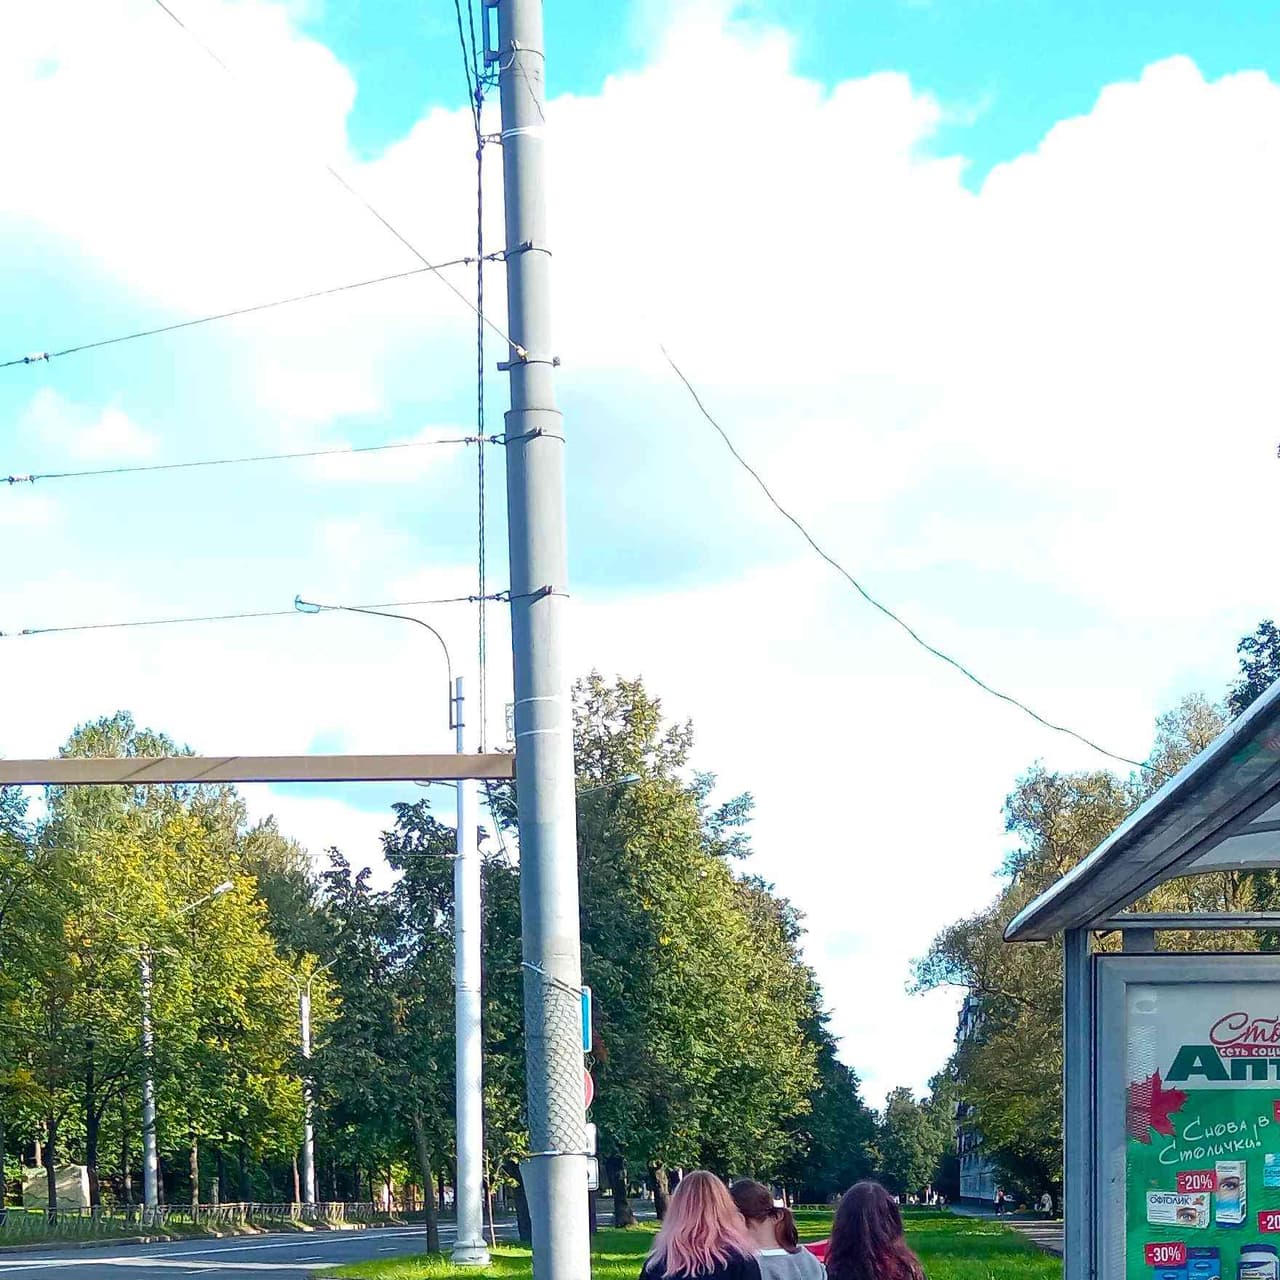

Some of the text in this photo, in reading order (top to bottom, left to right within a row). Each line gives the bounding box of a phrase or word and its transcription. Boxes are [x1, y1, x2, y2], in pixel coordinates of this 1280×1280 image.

[1220, 1047, 1248, 1057] сеть
[1180, 1174, 1213, 1190] -20%
[1147, 1246, 1181, 1262] -30%
